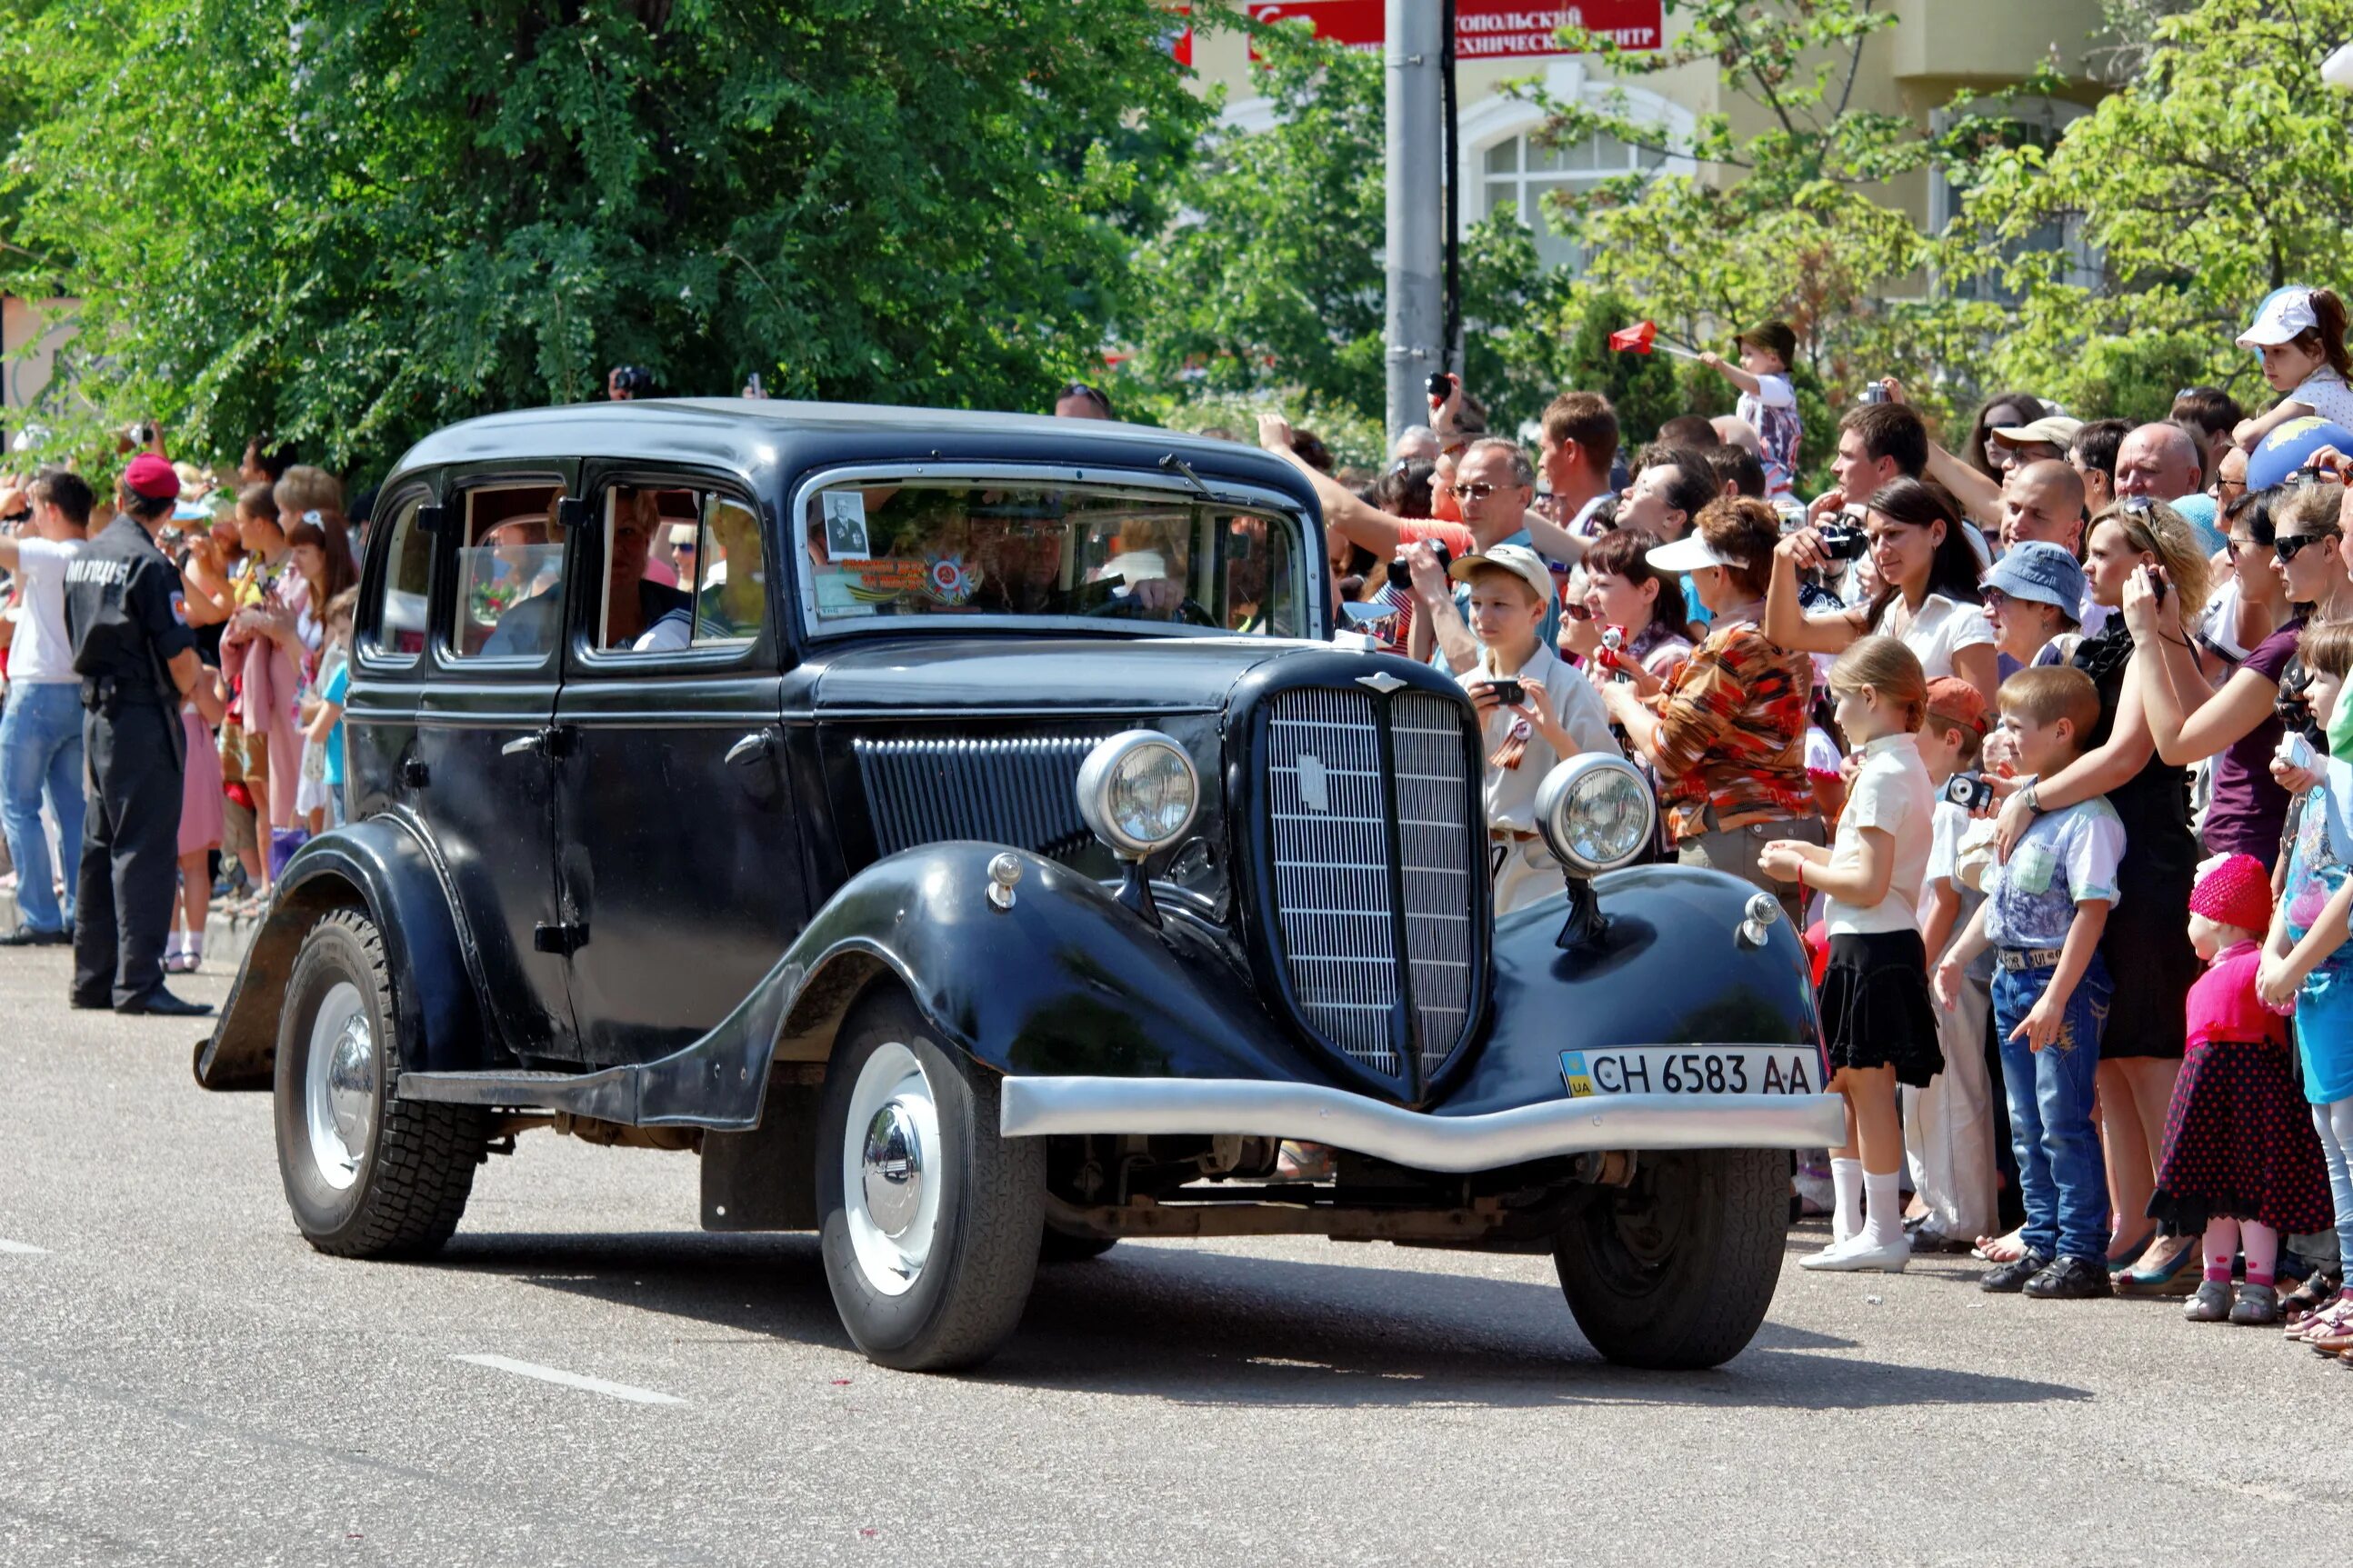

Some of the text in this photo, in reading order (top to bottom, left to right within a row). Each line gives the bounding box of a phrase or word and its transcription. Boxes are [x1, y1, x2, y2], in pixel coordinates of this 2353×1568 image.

[1593, 1054, 1811, 1094] CH 6583 AA
[1573, 1083, 1590, 1093] UA
